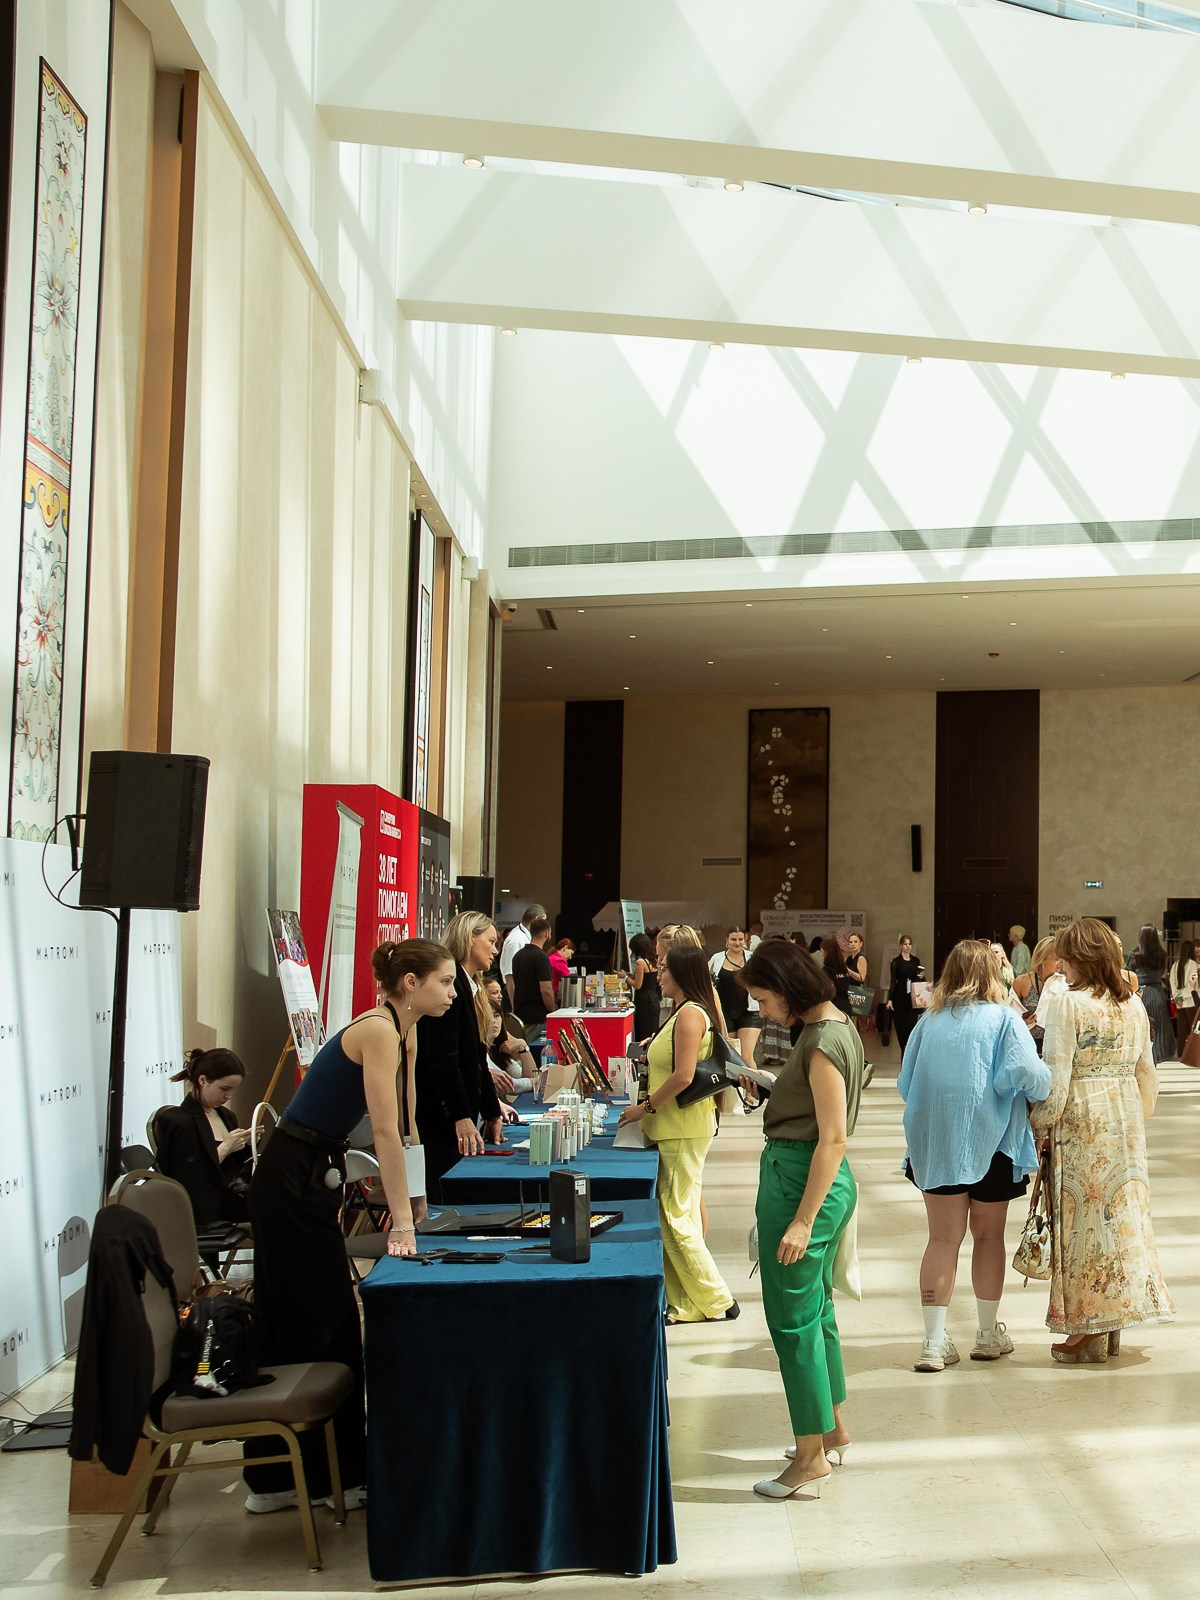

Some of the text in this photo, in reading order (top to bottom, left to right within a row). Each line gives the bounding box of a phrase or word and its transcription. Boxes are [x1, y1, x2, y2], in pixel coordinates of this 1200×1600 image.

[386, 855, 398, 885] ЛЕТ
[378, 888, 408, 919] ПОМОГАЕМ
[36, 946, 79, 960] MATROMI
[143, 943, 175, 955] MATROMI
[145, 1060, 177, 1077] MATROMI
[40, 1084, 82, 1106] MATROMI
[44, 1221, 86, 1254] MATROMI
